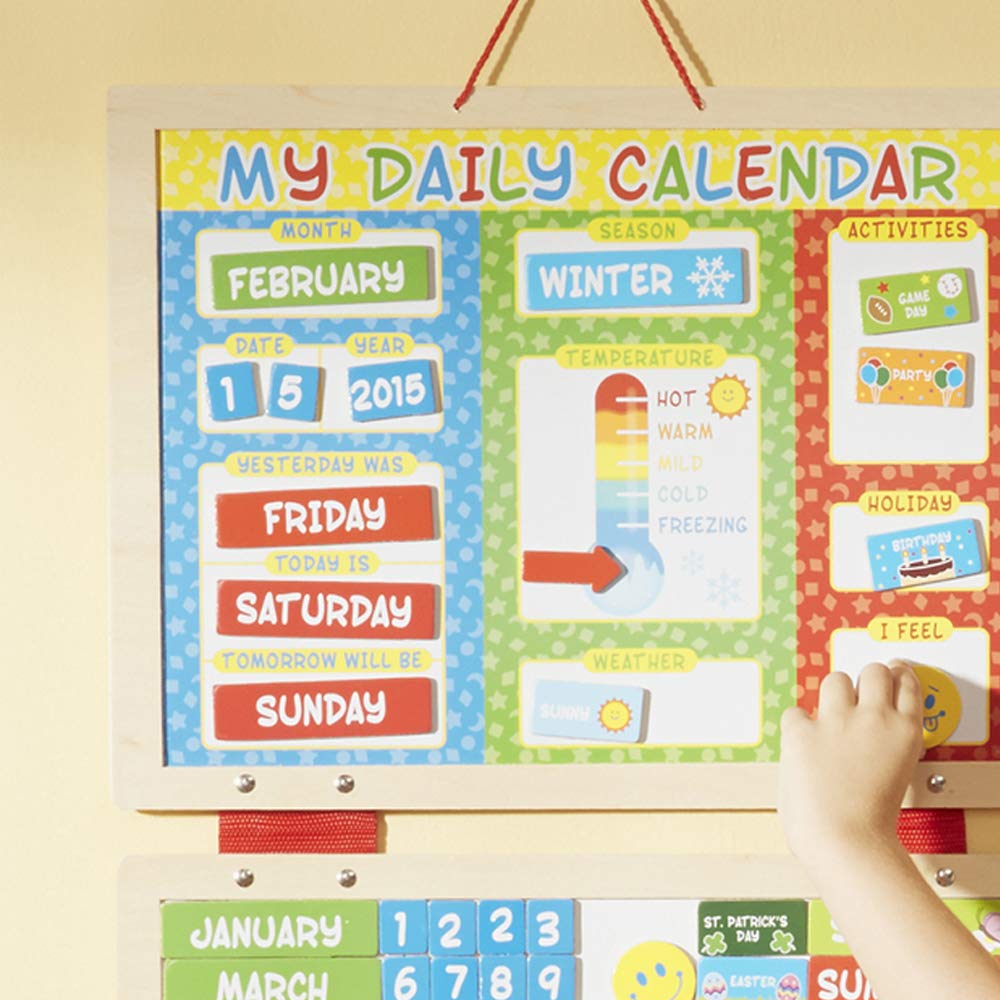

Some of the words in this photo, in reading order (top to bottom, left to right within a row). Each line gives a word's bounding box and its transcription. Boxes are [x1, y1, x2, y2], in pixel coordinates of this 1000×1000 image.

[219, 145, 328, 202] MY
[366, 145, 572, 202] DAILY
[609, 144, 956, 201] CALENDAR
[280, 222, 351, 238] MONTH
[600, 222, 676, 239] SEASON
[848, 221, 968, 239] ACTIVITIES
[228, 260, 405, 301] FEBRUARY
[537, 263, 673, 298] WINTER
[898, 289, 931, 305] GAME
[905, 304, 928, 319] DAY
[235, 338, 284, 355] DATE
[354, 338, 405, 354] YEAR
[566, 349, 714, 367] TEMPERATURE
[892, 368, 932, 383] PARTY
[220, 376, 234, 411] 1
[278, 375, 302, 410] 5
[353, 373, 425, 412] 2015
[657, 390, 696, 407] HOT
[658, 424, 713, 441] WARM
[237, 456, 354, 473] YESTERDAY
[364, 456, 403, 473] WAS
[658, 456, 703, 472] MILD
[658, 486, 708, 503] COLD
[867, 495, 953, 512] HOLIDAY
[263, 497, 387, 535] FRIDAY
[658, 517, 748, 534] FREEZING
[892, 530, 952, 552] BIRTHDAY
[275, 555, 340, 573] TODAY
[349, 555, 369, 572] IS
[236, 593, 412, 629] SATURDAY
[881, 623, 887, 640] I
[898, 623, 943, 640] FEEL
[222, 652, 341, 669] TOMORROW
[346, 652, 393, 669] WILL
[401, 652, 422, 668] BE
[593, 653, 686, 671] WEATHER
[256, 691, 387, 728] SUNDAY
[540, 703, 590, 722] SUNNY
[394, 912, 407, 947] 1
[438, 913, 462, 948] 2
[490, 907, 514, 943] 2
[536, 912, 560, 947] 3
[703, 915, 723, 929] ST.
[727, 915, 788, 929] PATRICK'S
[190, 915, 342, 950] JANUARY
[736, 929, 760, 944] DAY
[445, 965, 468, 999] 7
[490, 966, 512, 1000] 8
[538, 965, 561, 999] 9
[730, 975, 776, 990] EASTER
